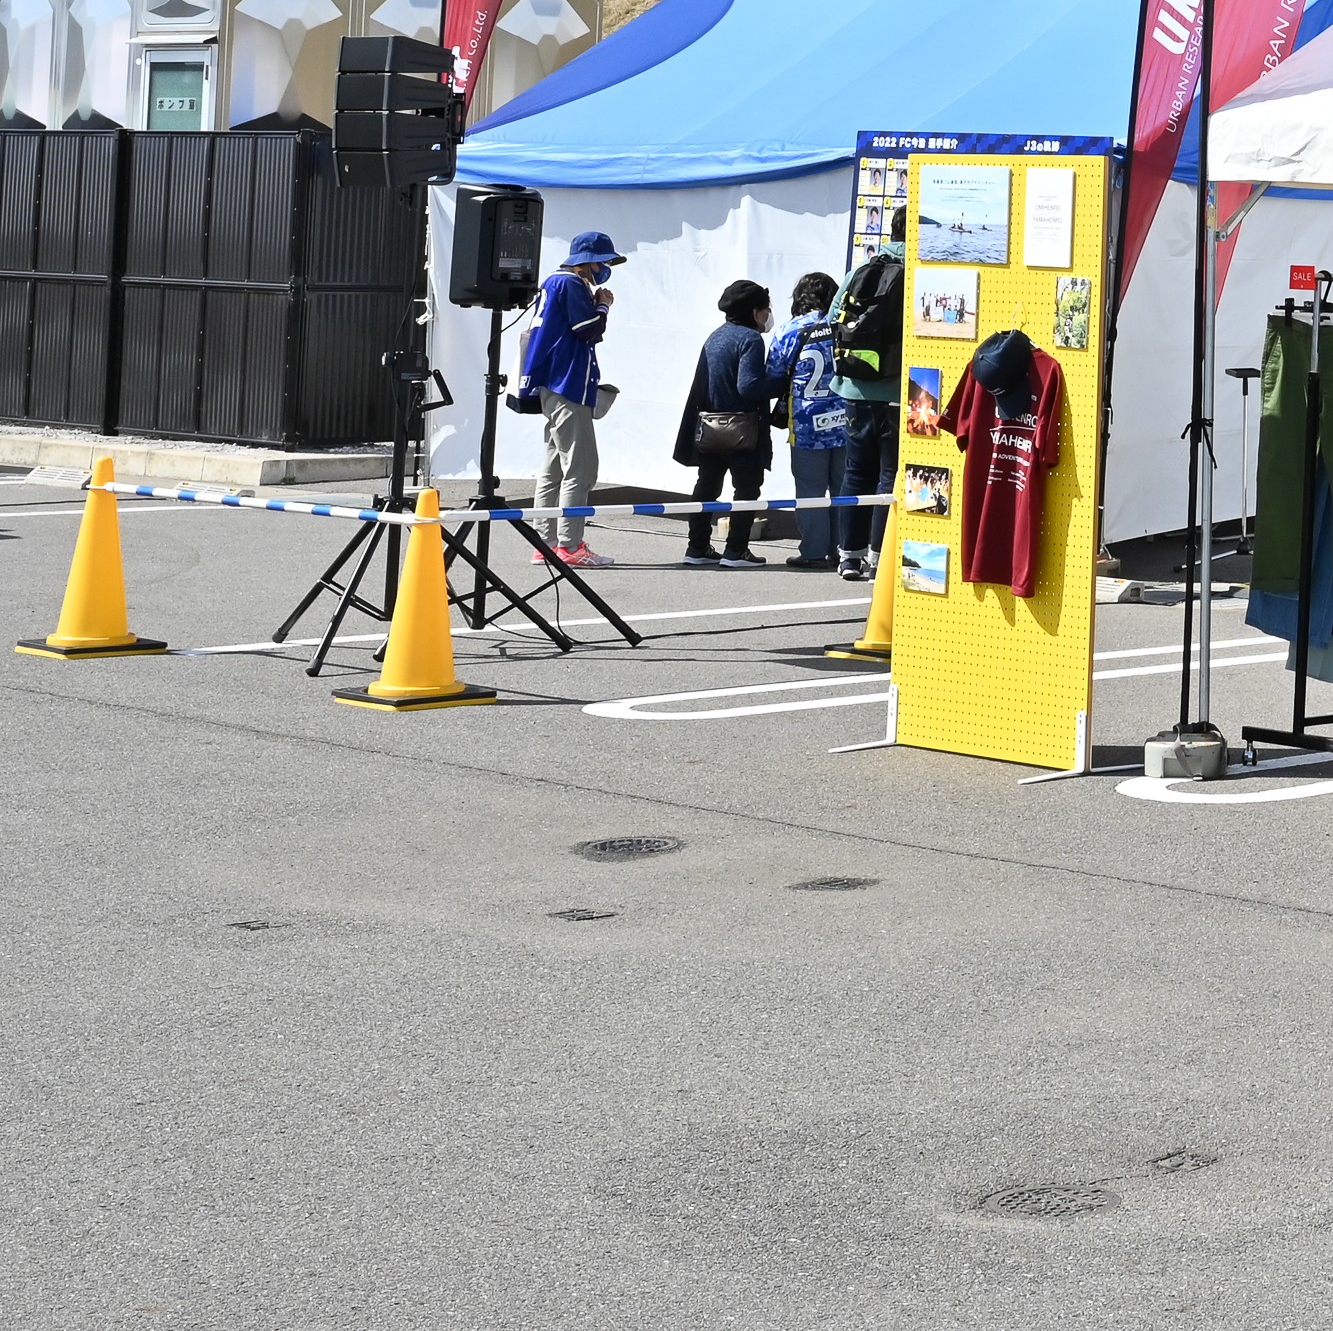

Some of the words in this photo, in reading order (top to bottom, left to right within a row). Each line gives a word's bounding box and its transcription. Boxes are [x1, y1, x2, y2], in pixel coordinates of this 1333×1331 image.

[157, 98, 197, 111] ポンプ室
[1166, 76, 1190, 134] URBAN
[872, 136, 897, 148] 2022
[1292, 272, 1312, 281] SALE
